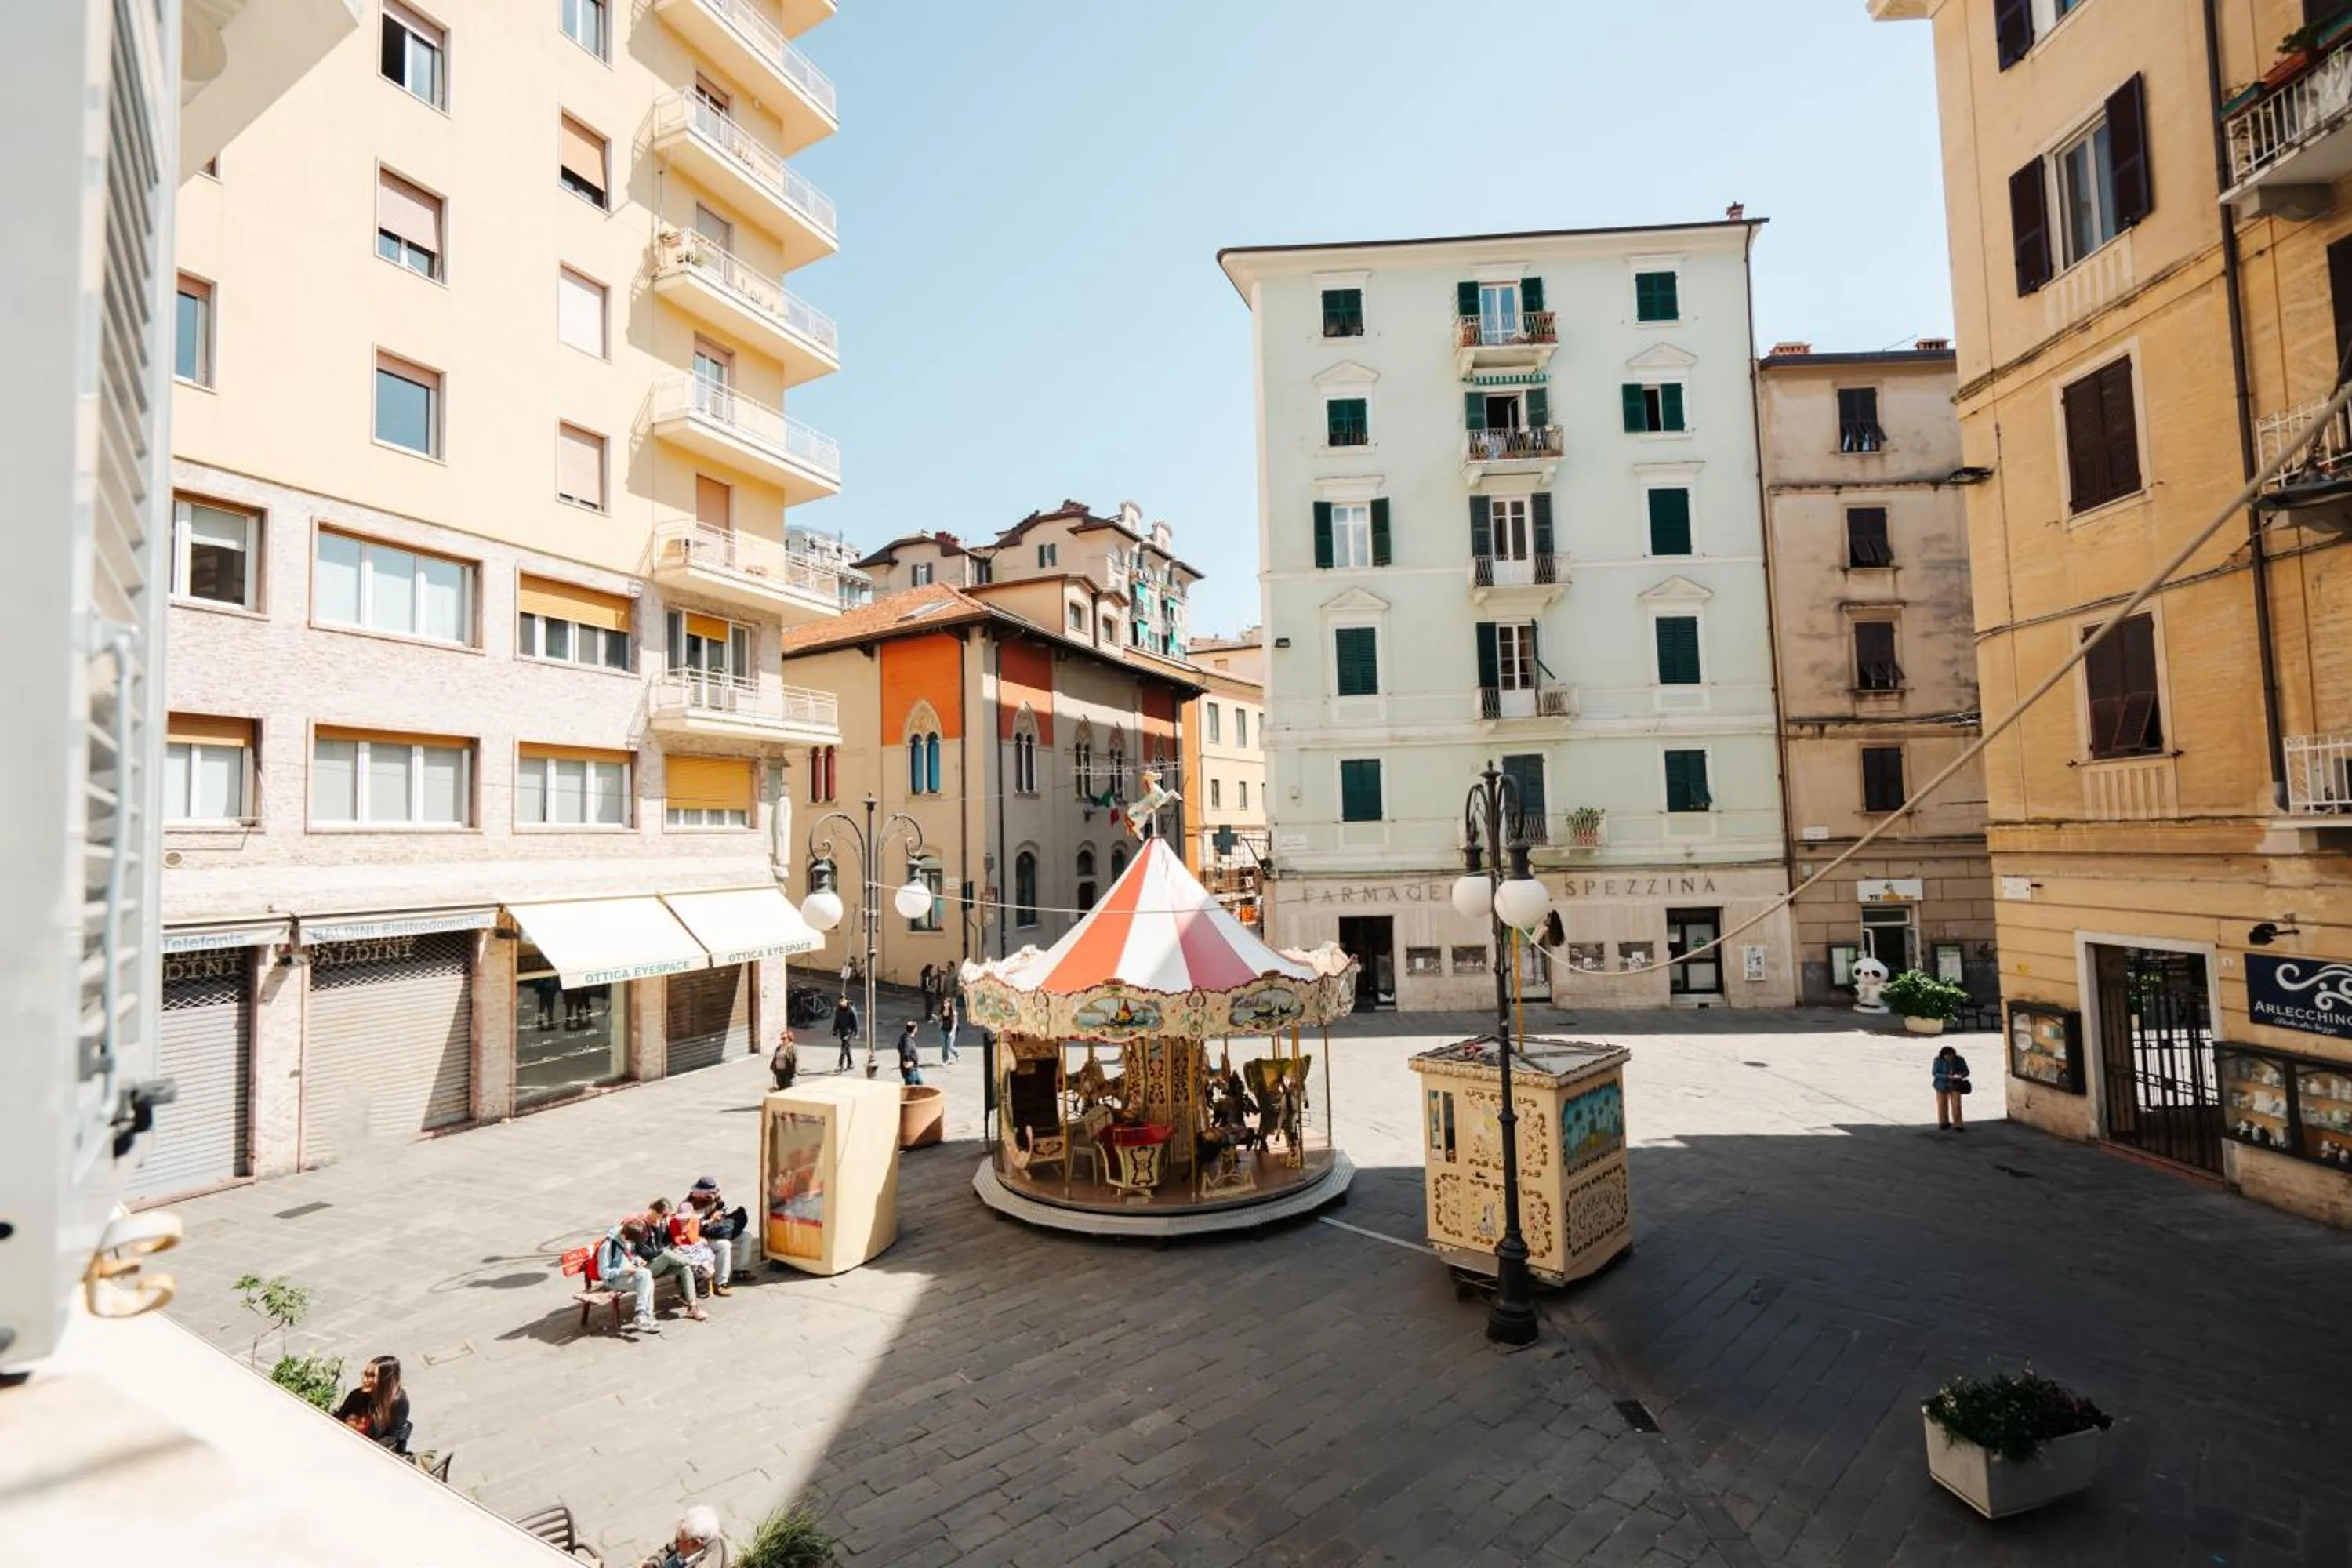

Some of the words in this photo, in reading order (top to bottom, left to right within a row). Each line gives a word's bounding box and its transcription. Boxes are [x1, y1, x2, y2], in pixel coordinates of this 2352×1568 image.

[1565, 877, 1717, 896] SPEZZINA
[728, 949, 764, 964] OTTICA
[766, 942, 812, 957] EYESPACE
[585, 968, 629, 984] OTTICA
[633, 960, 691, 977] EYESPACE
